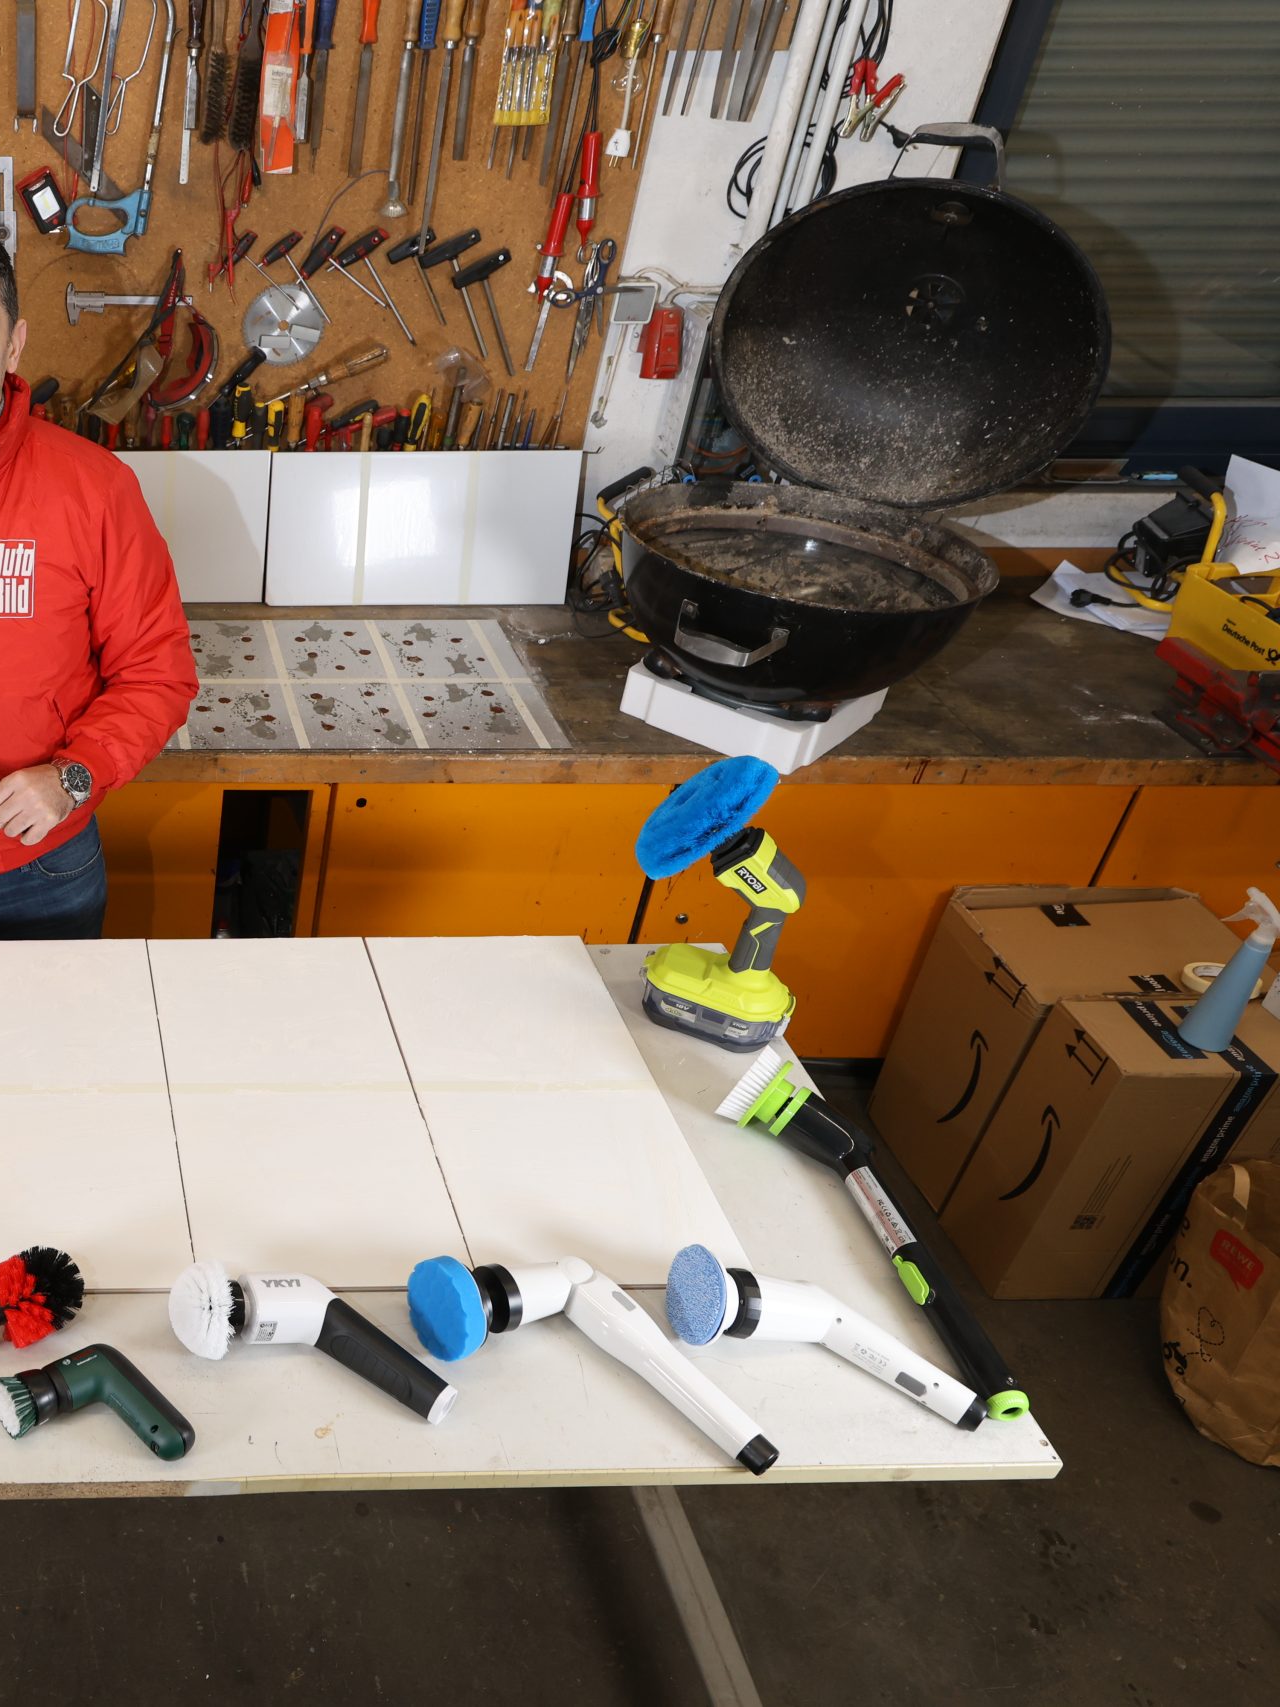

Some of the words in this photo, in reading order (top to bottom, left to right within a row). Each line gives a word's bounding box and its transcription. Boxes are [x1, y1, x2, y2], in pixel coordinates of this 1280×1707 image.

[1222, 623, 1250, 647] Deutsche
[1250, 641, 1266, 656] Post
[737, 867, 765, 893] RYOBI
[1137, 1005, 1163, 1028] prime
[1201, 1133, 1221, 1163] amazon
[1217, 1115, 1235, 1141] prime
[1221, 1239, 1256, 1271] REWE
[261, 1278, 301, 1288] YKYI
